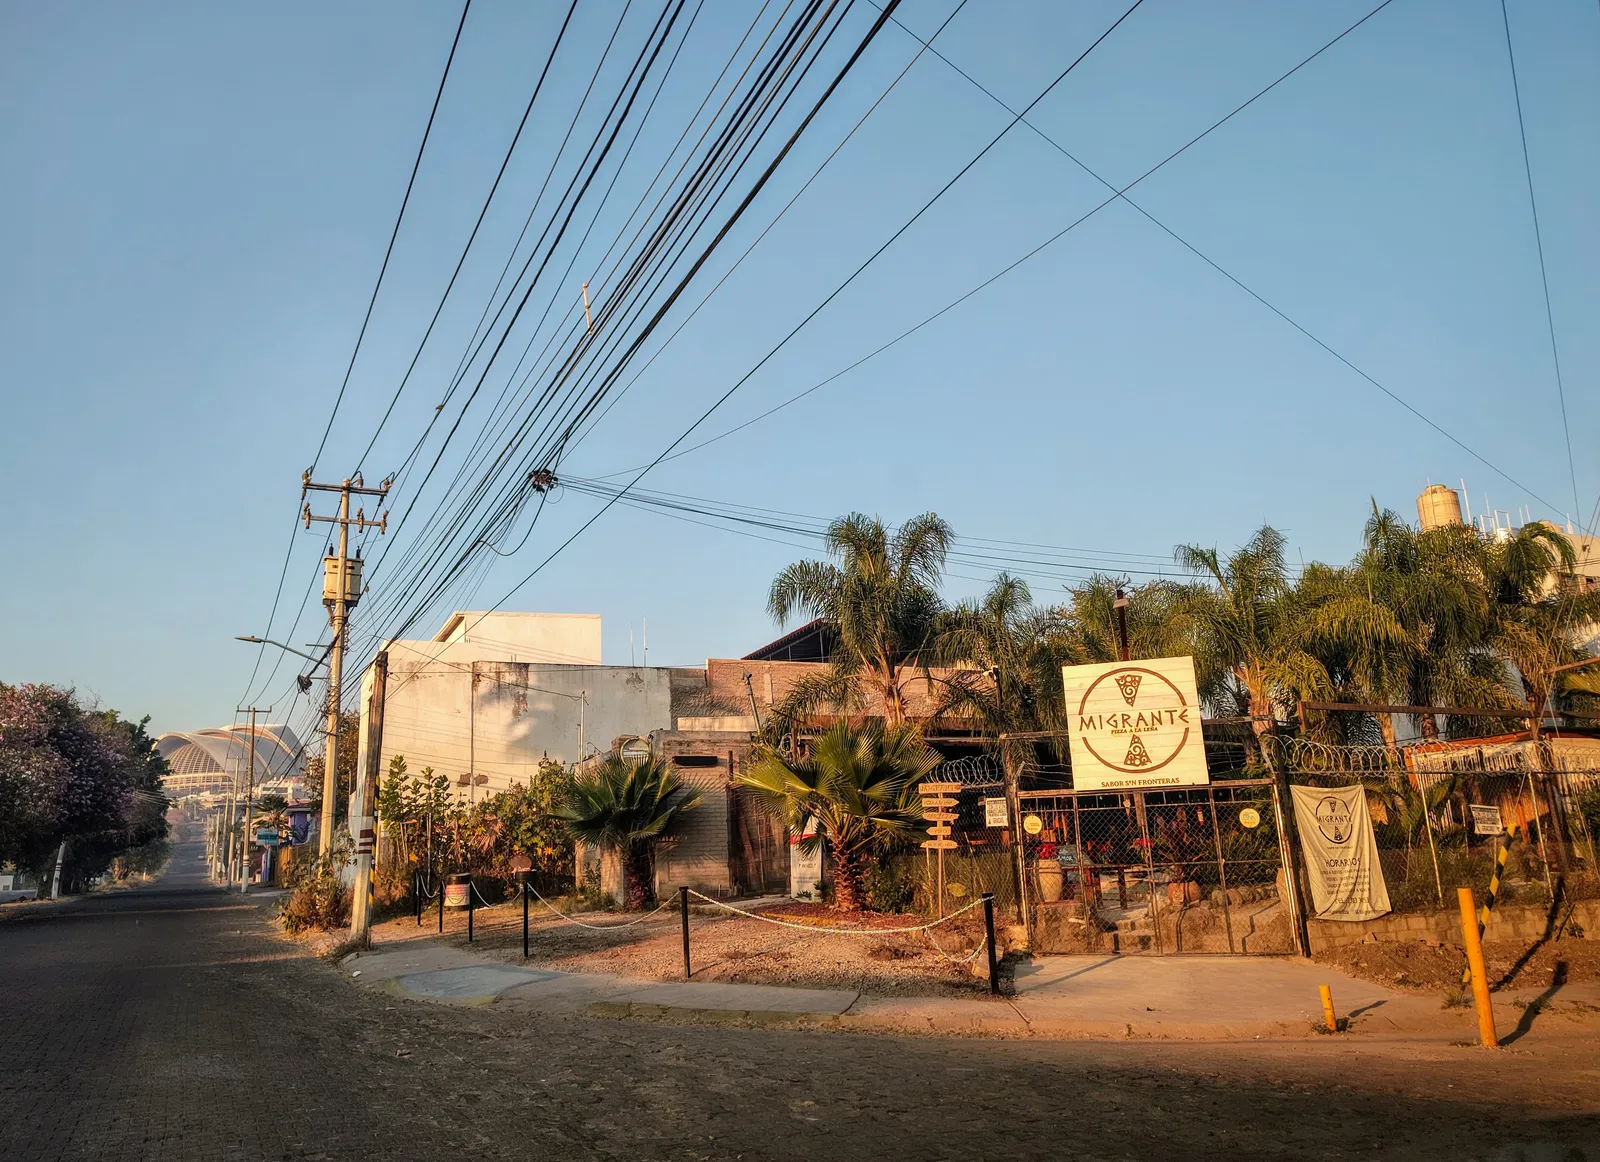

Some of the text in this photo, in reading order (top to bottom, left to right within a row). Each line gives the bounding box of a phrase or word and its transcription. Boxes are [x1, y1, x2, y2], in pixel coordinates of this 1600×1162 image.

[1079, 708, 1190, 731] MIGRANTE
[1101, 780, 1124, 788] SABOR
[1138, 777, 1180, 786] FRONTERAS
[1316, 815, 1352, 823] MIGRANTE
